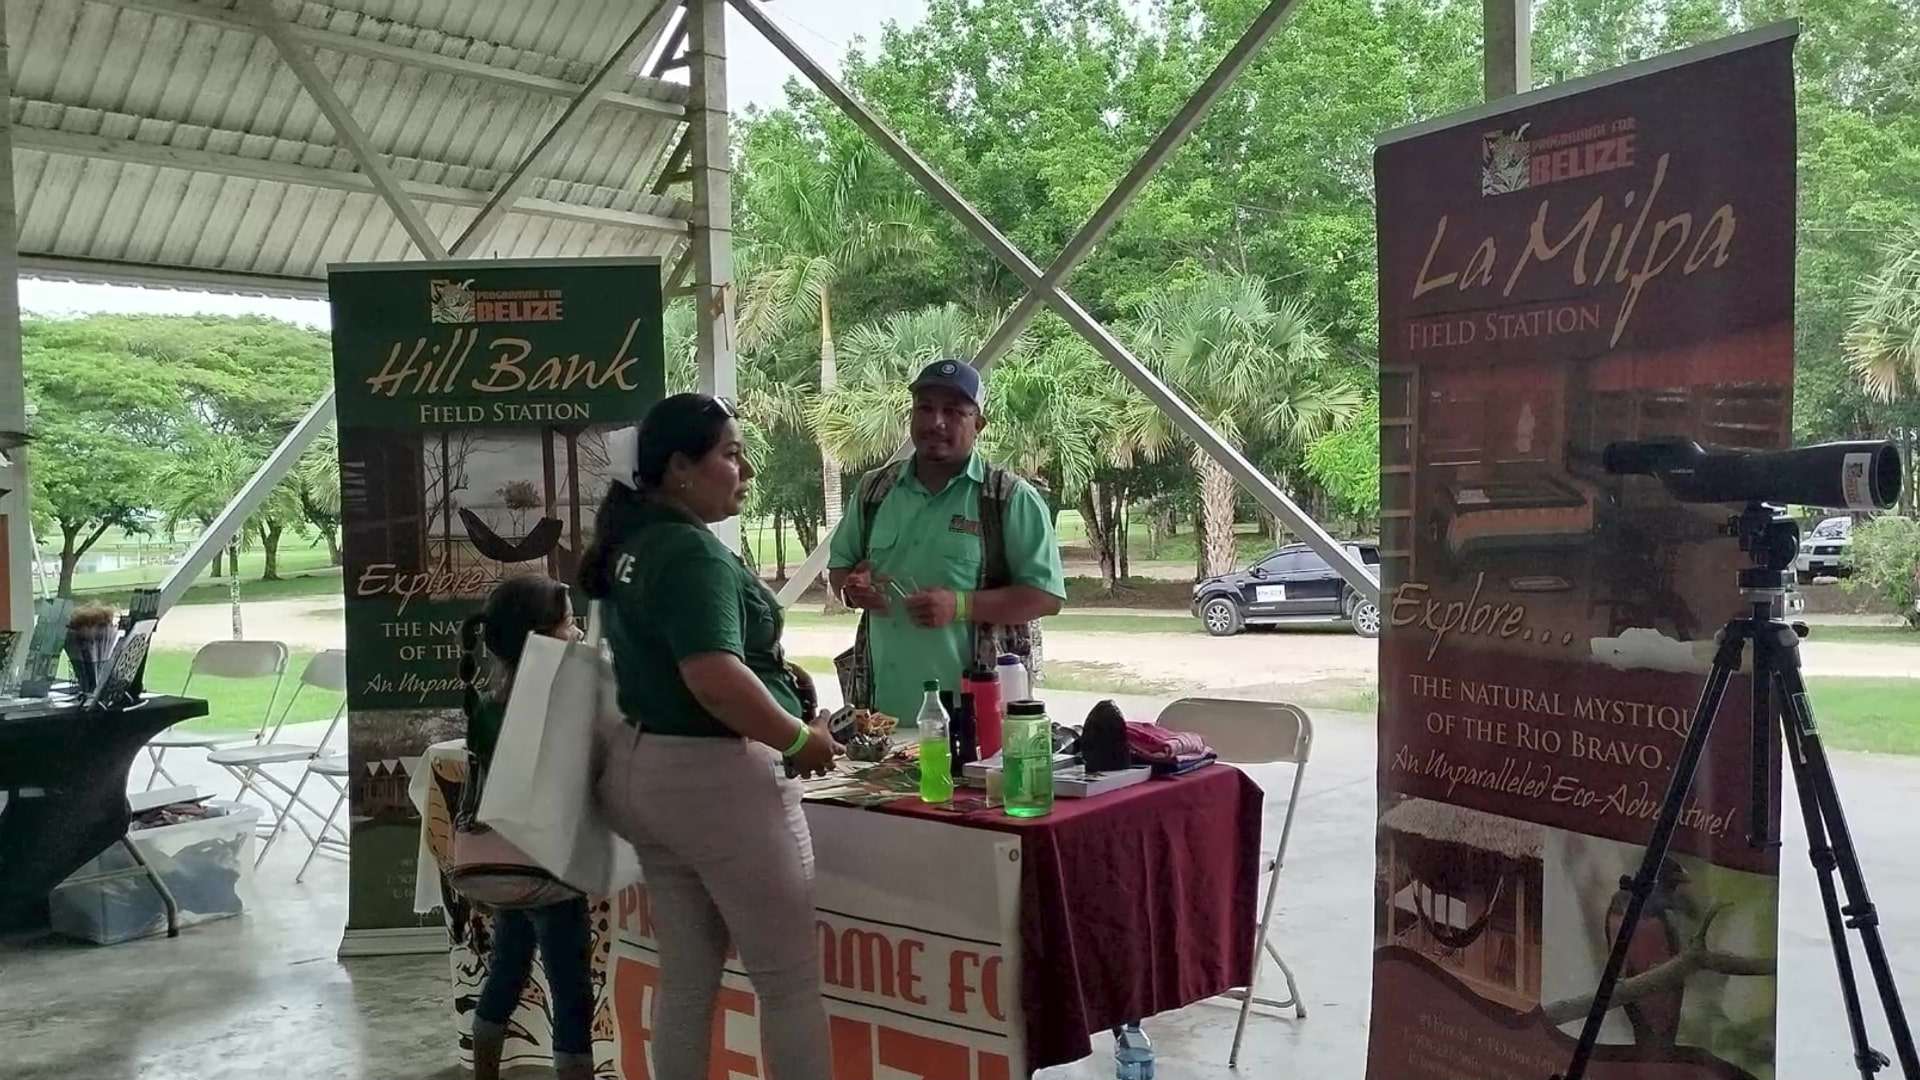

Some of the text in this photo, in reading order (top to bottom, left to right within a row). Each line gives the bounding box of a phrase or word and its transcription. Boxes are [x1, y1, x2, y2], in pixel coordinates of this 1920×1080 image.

[1530, 134, 1636, 186] BELIZE
[1411, 152, 1738, 349] La Milpa
[476, 300, 564, 322] BELIZE
[1408, 303, 1601, 351] FIELD STATION
[365, 317, 641, 398] Hill Bank
[419, 402, 591, 424] FIELD STATION
[379, 621, 422, 637] THE
[399, 645, 426, 661] OF
[432, 644, 462, 660] TH
[362, 673, 394, 696] An
[1409, 673, 1696, 739] THE NATURAL MYSTIQU
[1426, 712, 1456, 737] OF
[1463, 717, 1508, 745] THE
[1516, 722, 1562, 754] RIO
[1391, 744, 1421, 774] An
[1426, 748, 1552, 796] Unparalleled
[948, 950, 1008, 1023] FO
